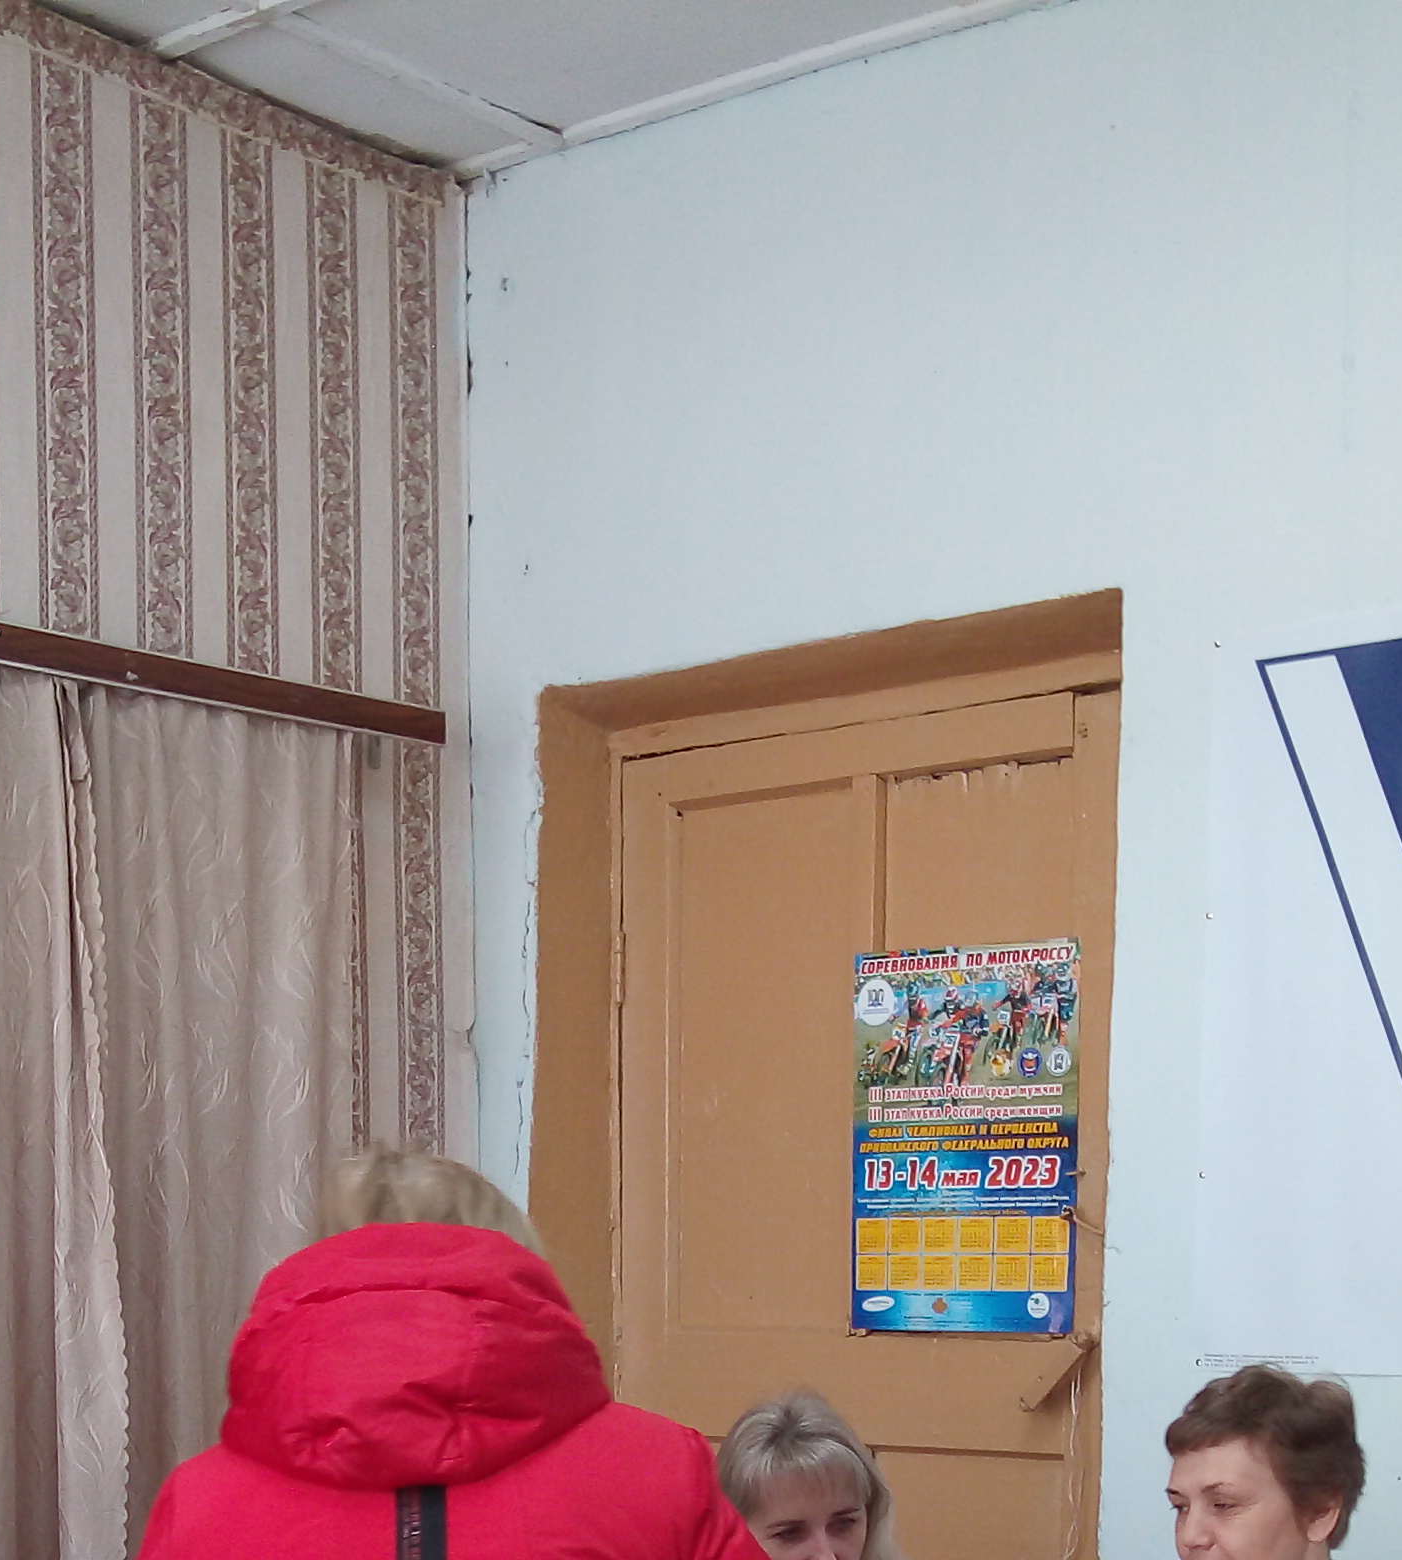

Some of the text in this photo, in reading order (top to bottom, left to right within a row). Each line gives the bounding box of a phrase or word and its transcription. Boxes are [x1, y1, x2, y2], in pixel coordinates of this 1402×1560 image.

[861, 945, 1074, 974] СОРЕВНОВАНИЯ ПО МОТОКРОССУ
[865, 1157, 938, 1190] 13-14
[986, 1156, 1059, 1188] 2023
